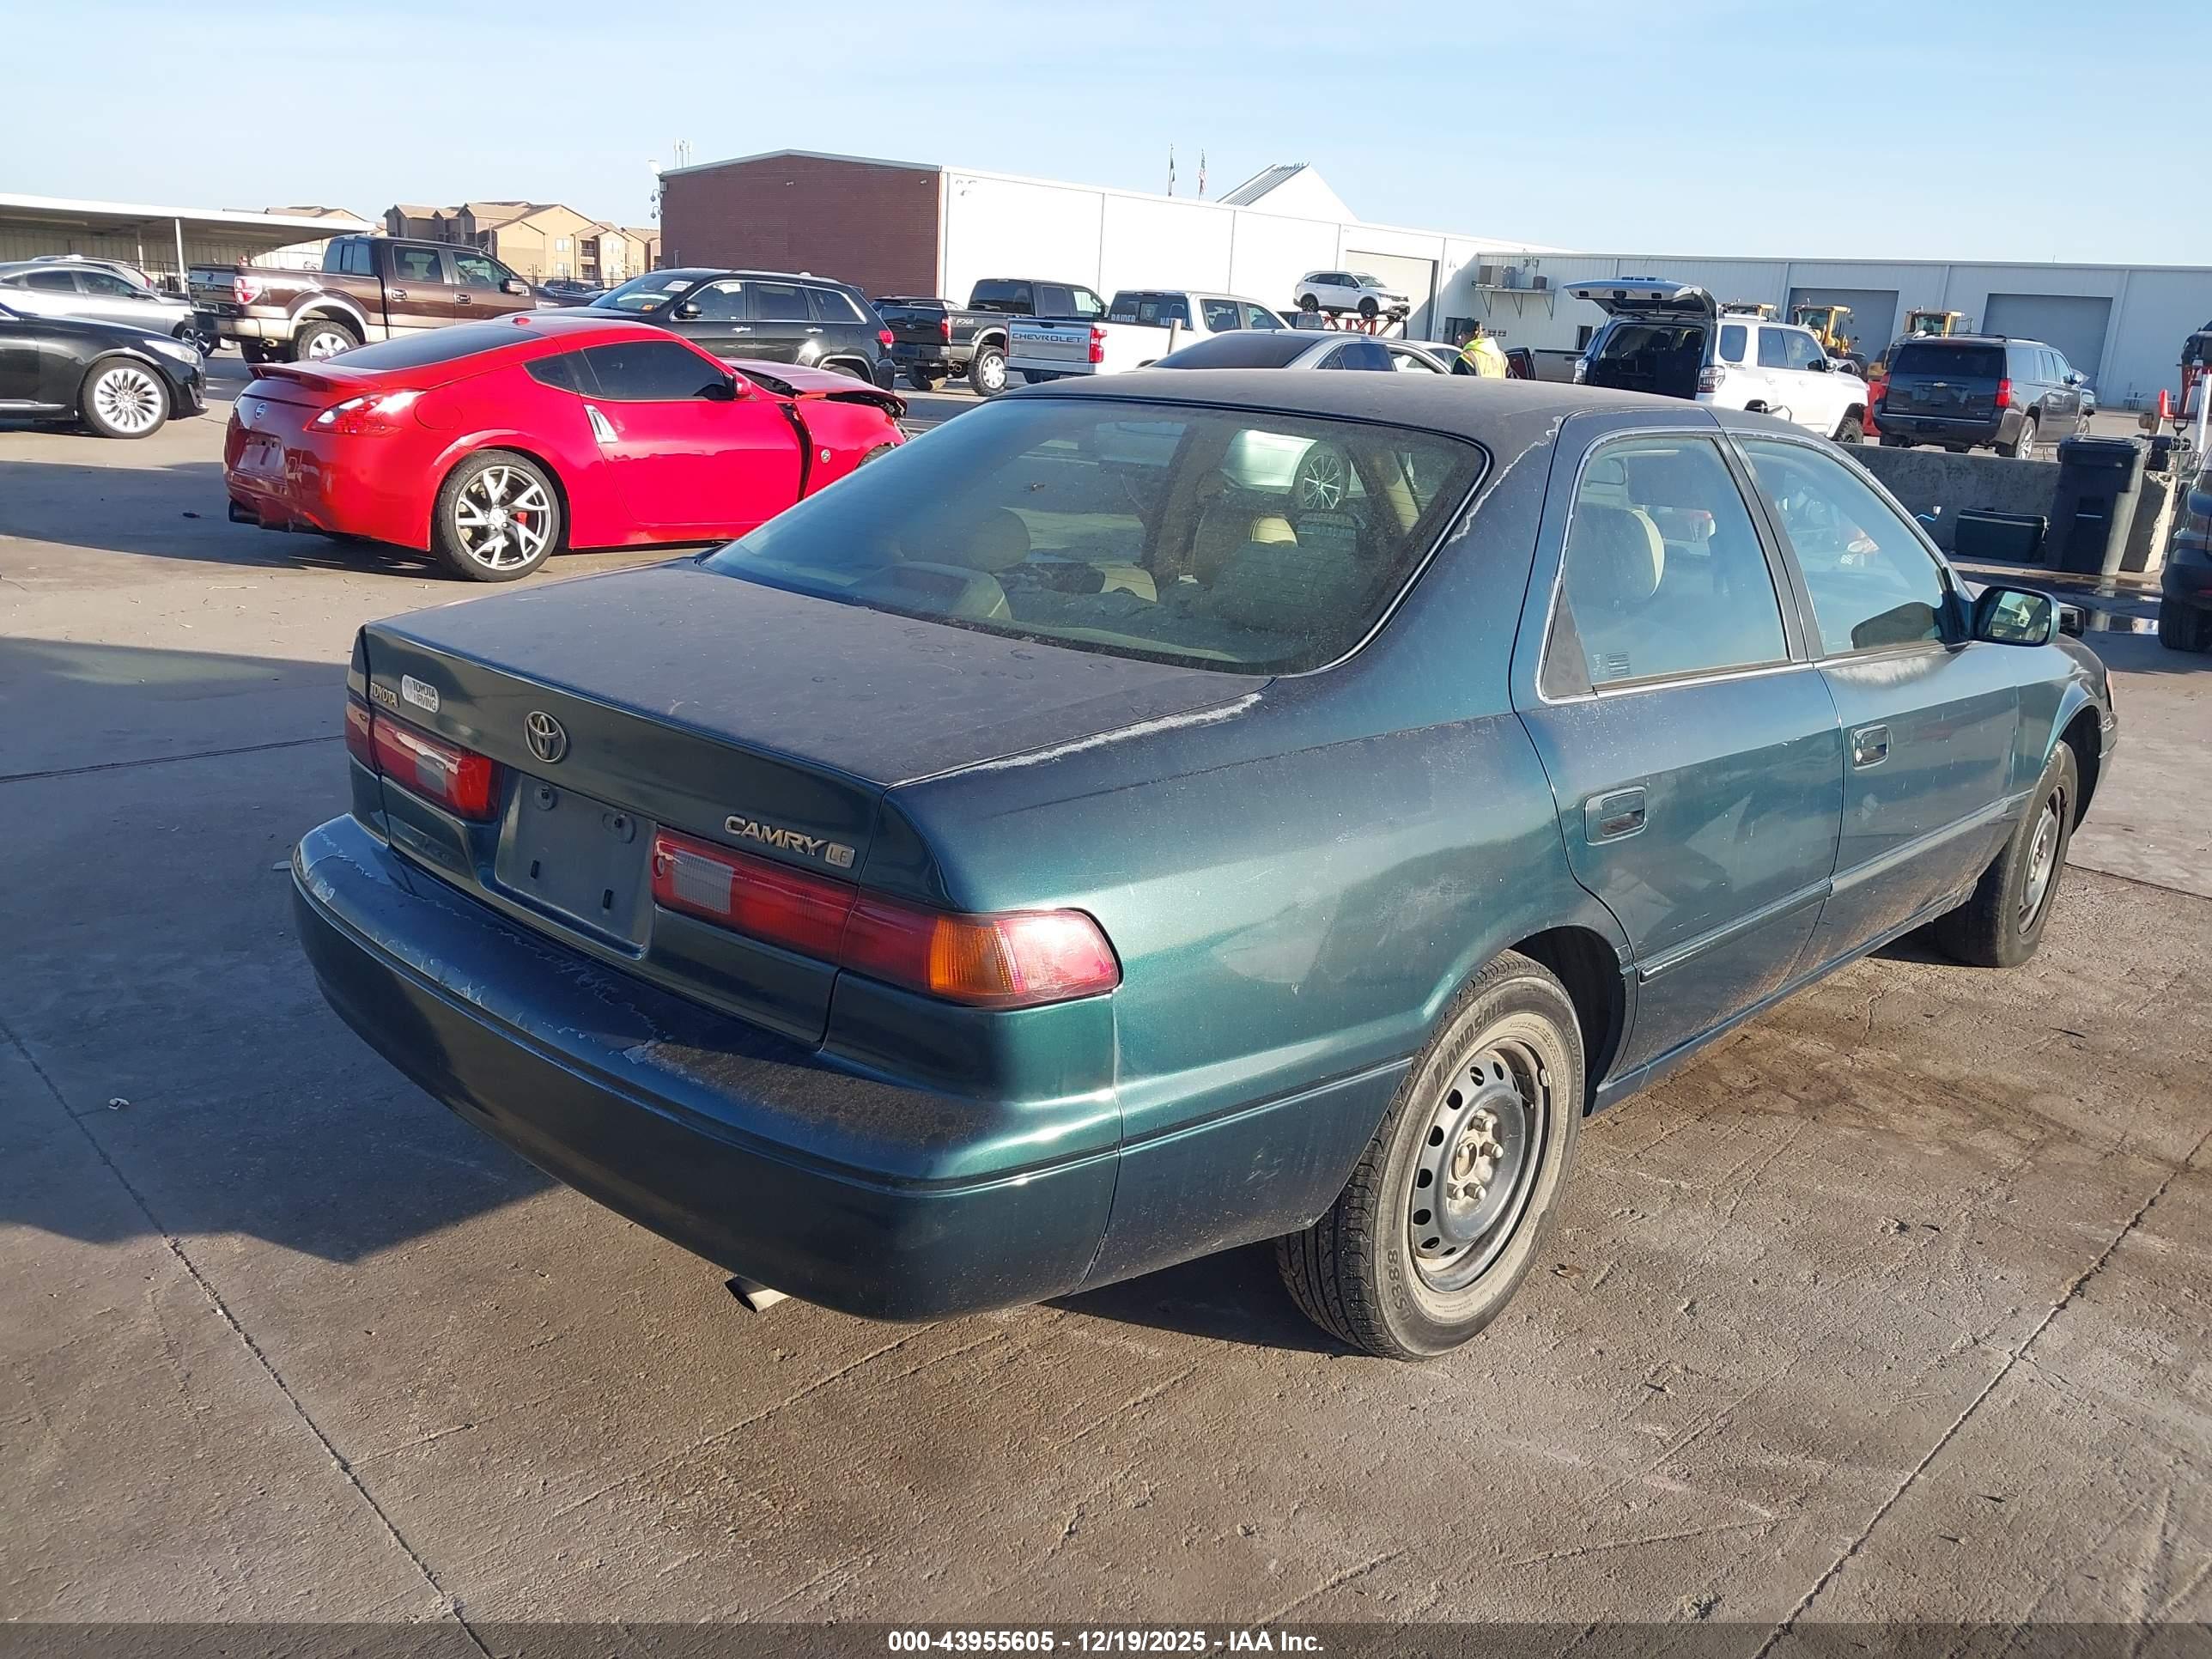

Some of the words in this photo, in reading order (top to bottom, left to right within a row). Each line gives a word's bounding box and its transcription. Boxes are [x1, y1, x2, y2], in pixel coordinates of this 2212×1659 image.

[1012, 332, 1083, 343] CHEVROLET
[371, 681, 399, 708] TOYOTA
[412, 680, 436, 699] TOYOTA
[725, 815, 828, 856] CAMRY
[828, 845, 851, 866] LE
[1387, 1249, 1413, 1321] LS388
